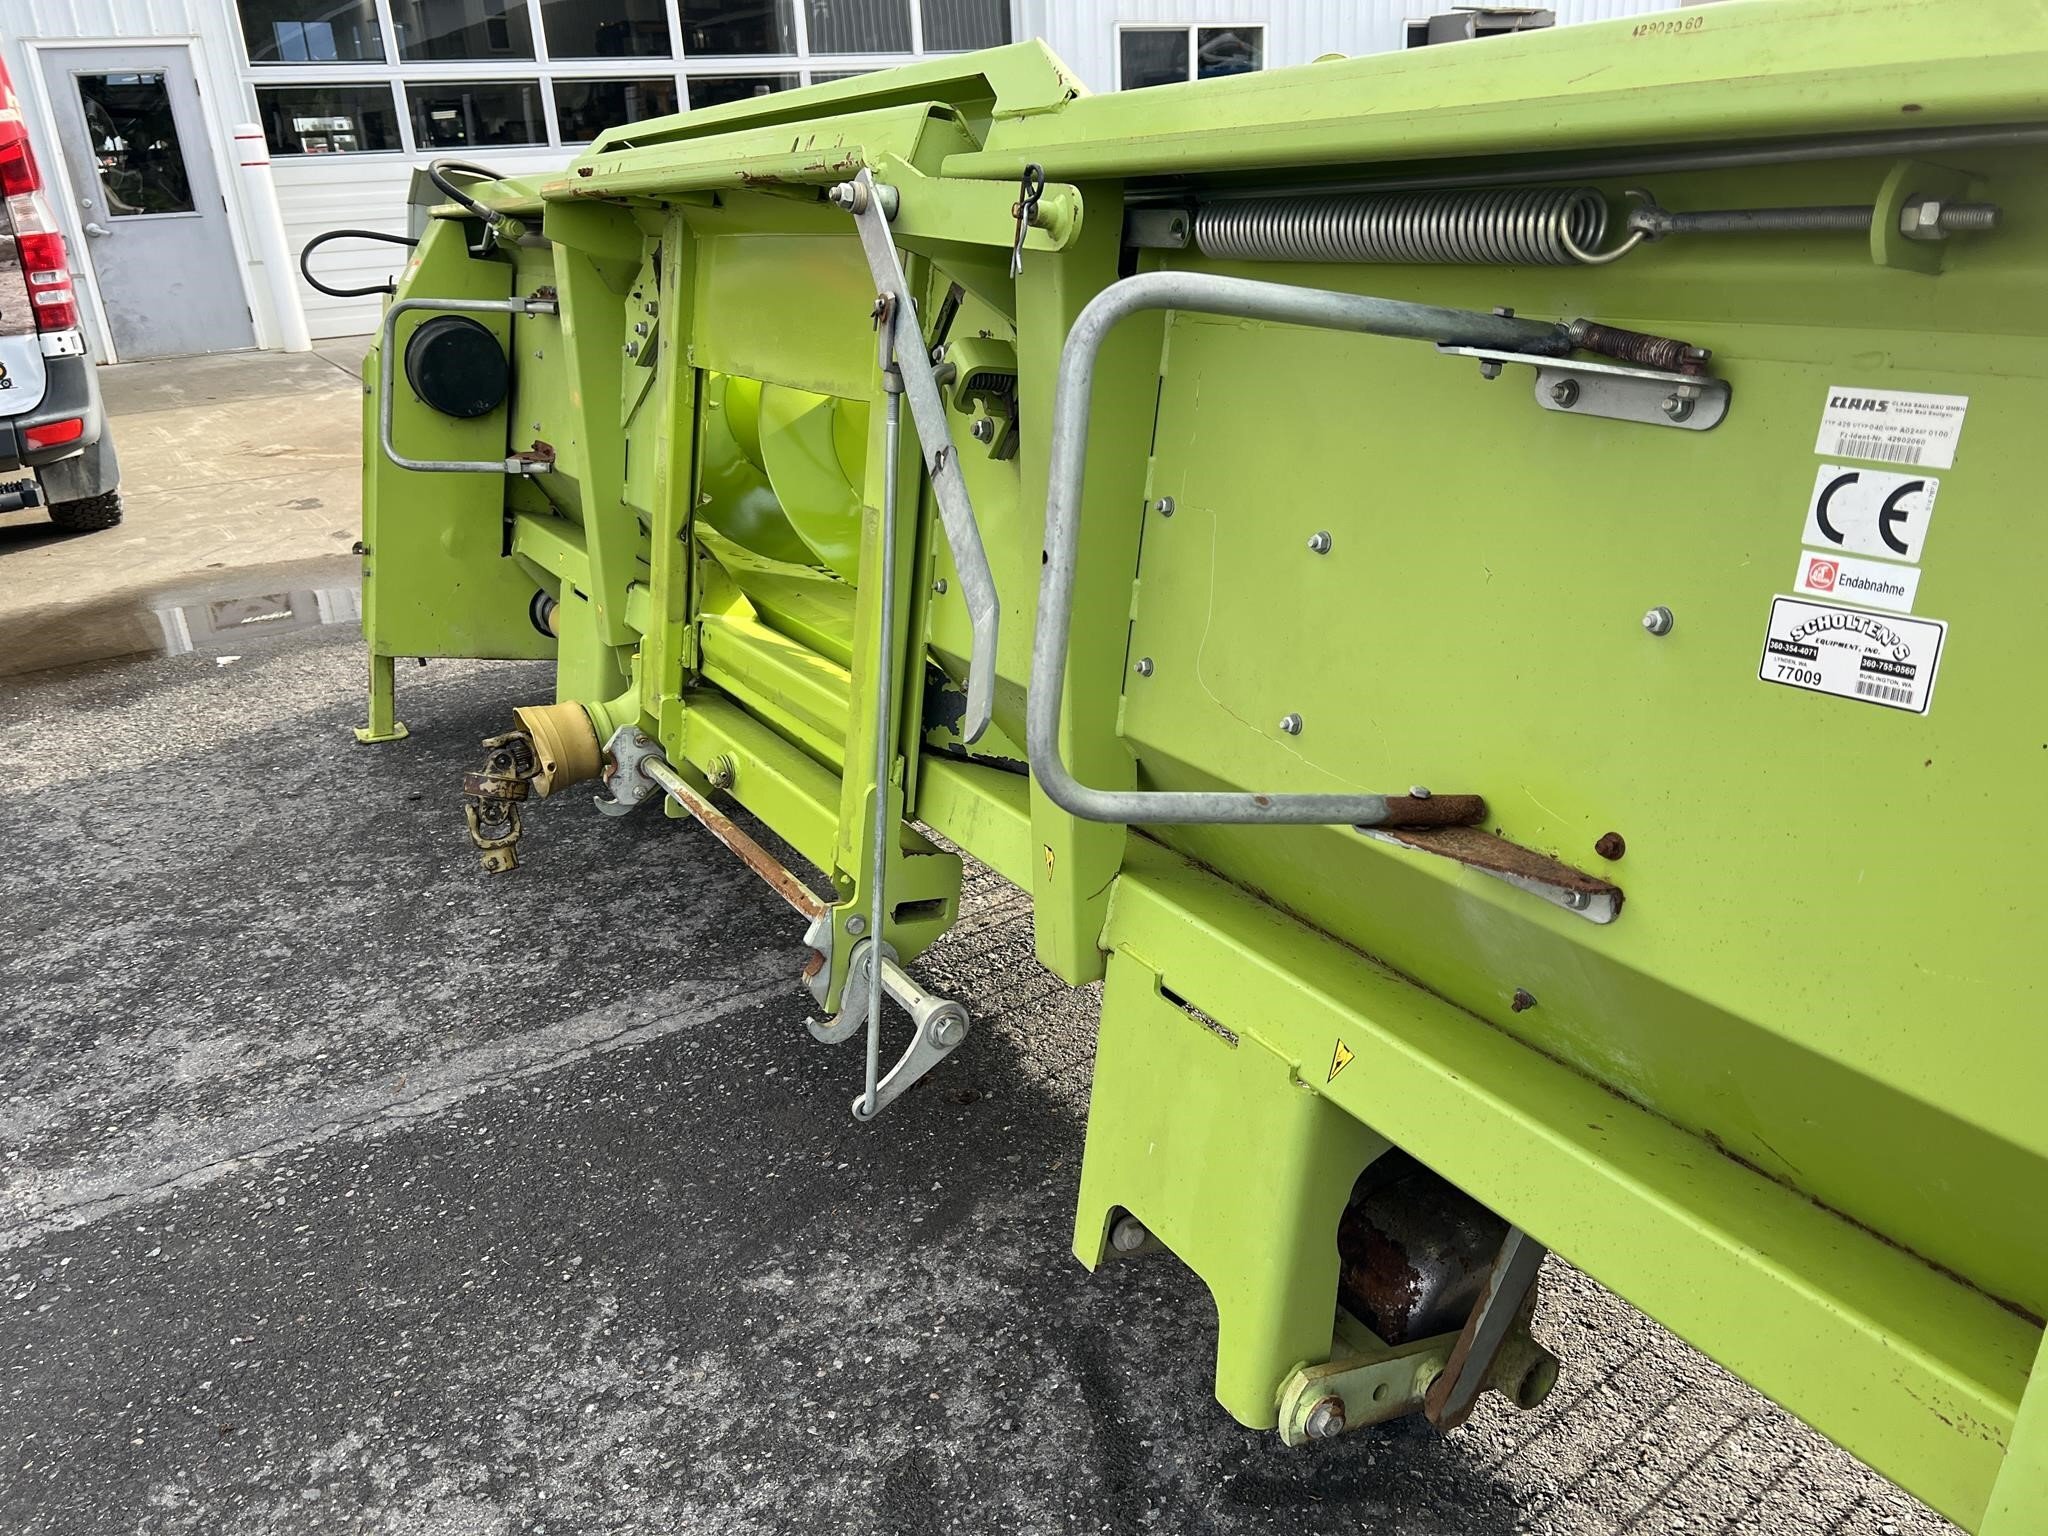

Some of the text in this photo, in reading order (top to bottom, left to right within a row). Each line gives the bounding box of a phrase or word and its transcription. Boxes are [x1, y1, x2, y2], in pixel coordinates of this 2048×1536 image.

[1830, 396, 1890, 413] CLAAS
[1816, 472, 1925, 555] CE
[1838, 573, 1905, 597] Endabnahme
[1769, 640, 1817, 657] 360-354-4071
[1790, 614, 1911, 661] SCHOLTEN'S
[1777, 664, 1822, 686] 77009
[1862, 658, 1915, 676] 360-755-0560
